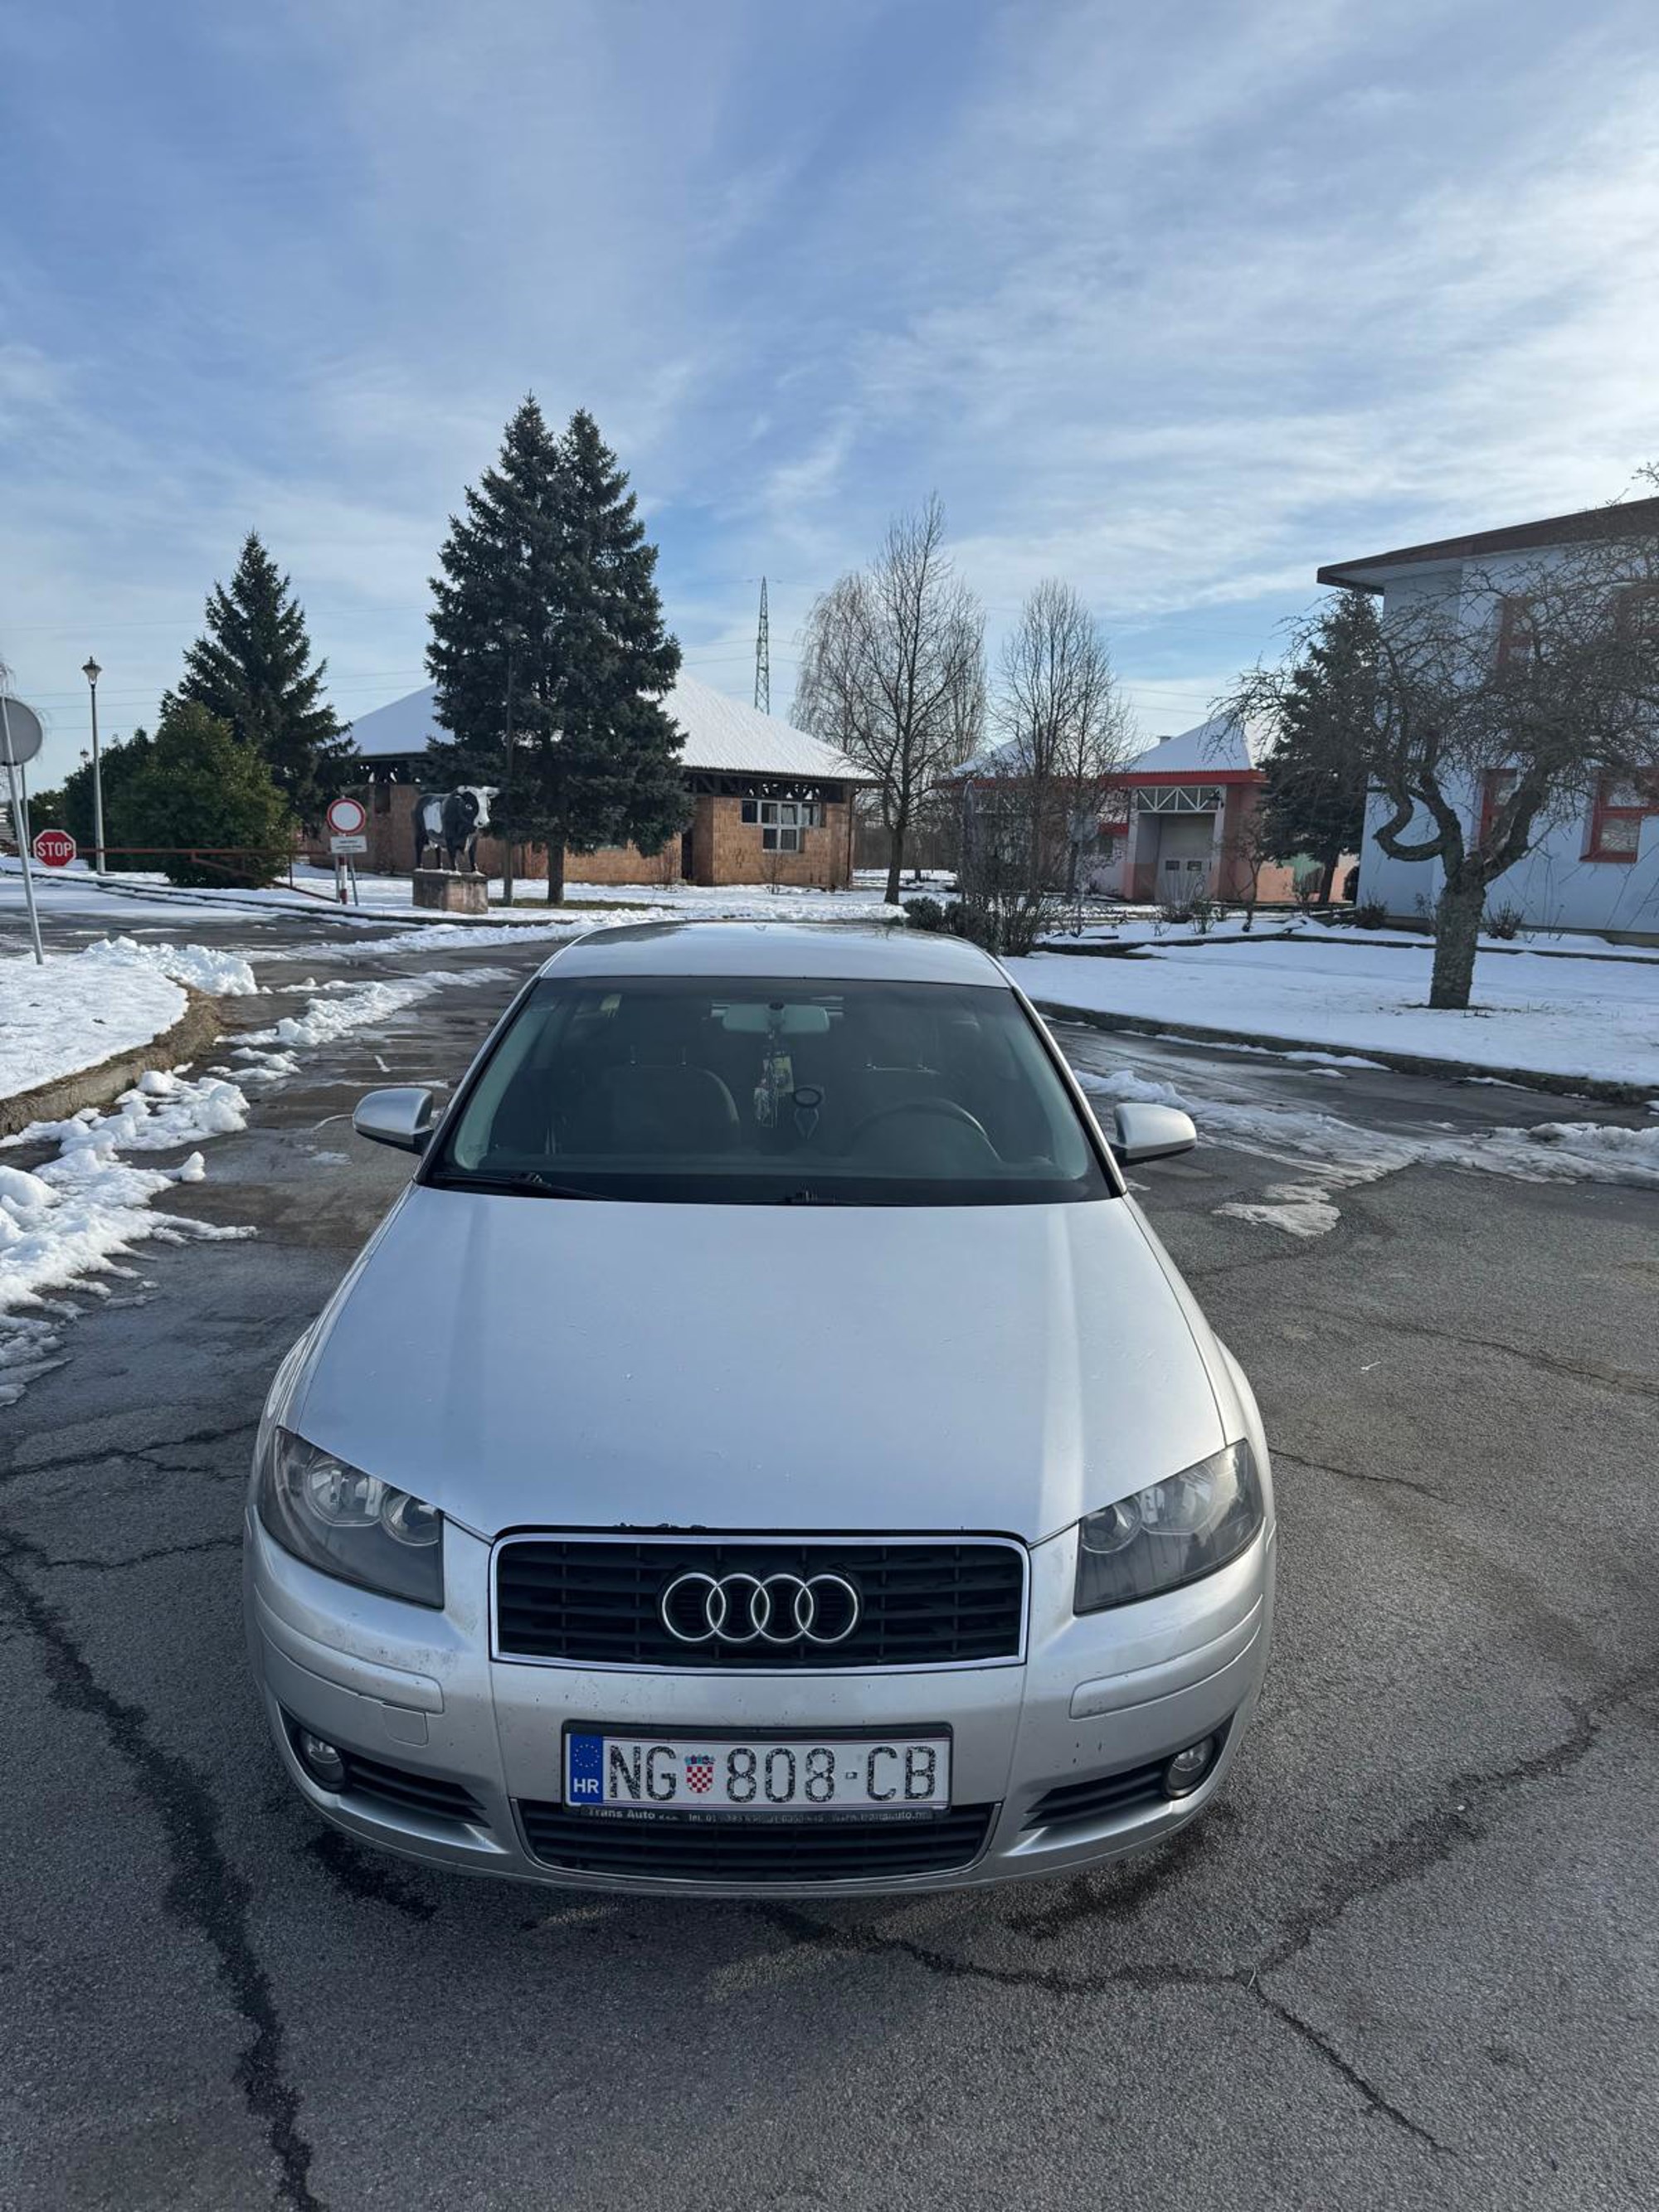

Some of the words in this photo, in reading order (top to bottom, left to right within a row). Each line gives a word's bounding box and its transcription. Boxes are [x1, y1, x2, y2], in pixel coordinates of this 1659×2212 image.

[37, 841, 73, 857] STOP
[609, 1744, 677, 1801] NG
[572, 1778, 600, 1794] HR
[588, 1807, 623, 1819] Trans
[627, 1809, 656, 1820] Auto
